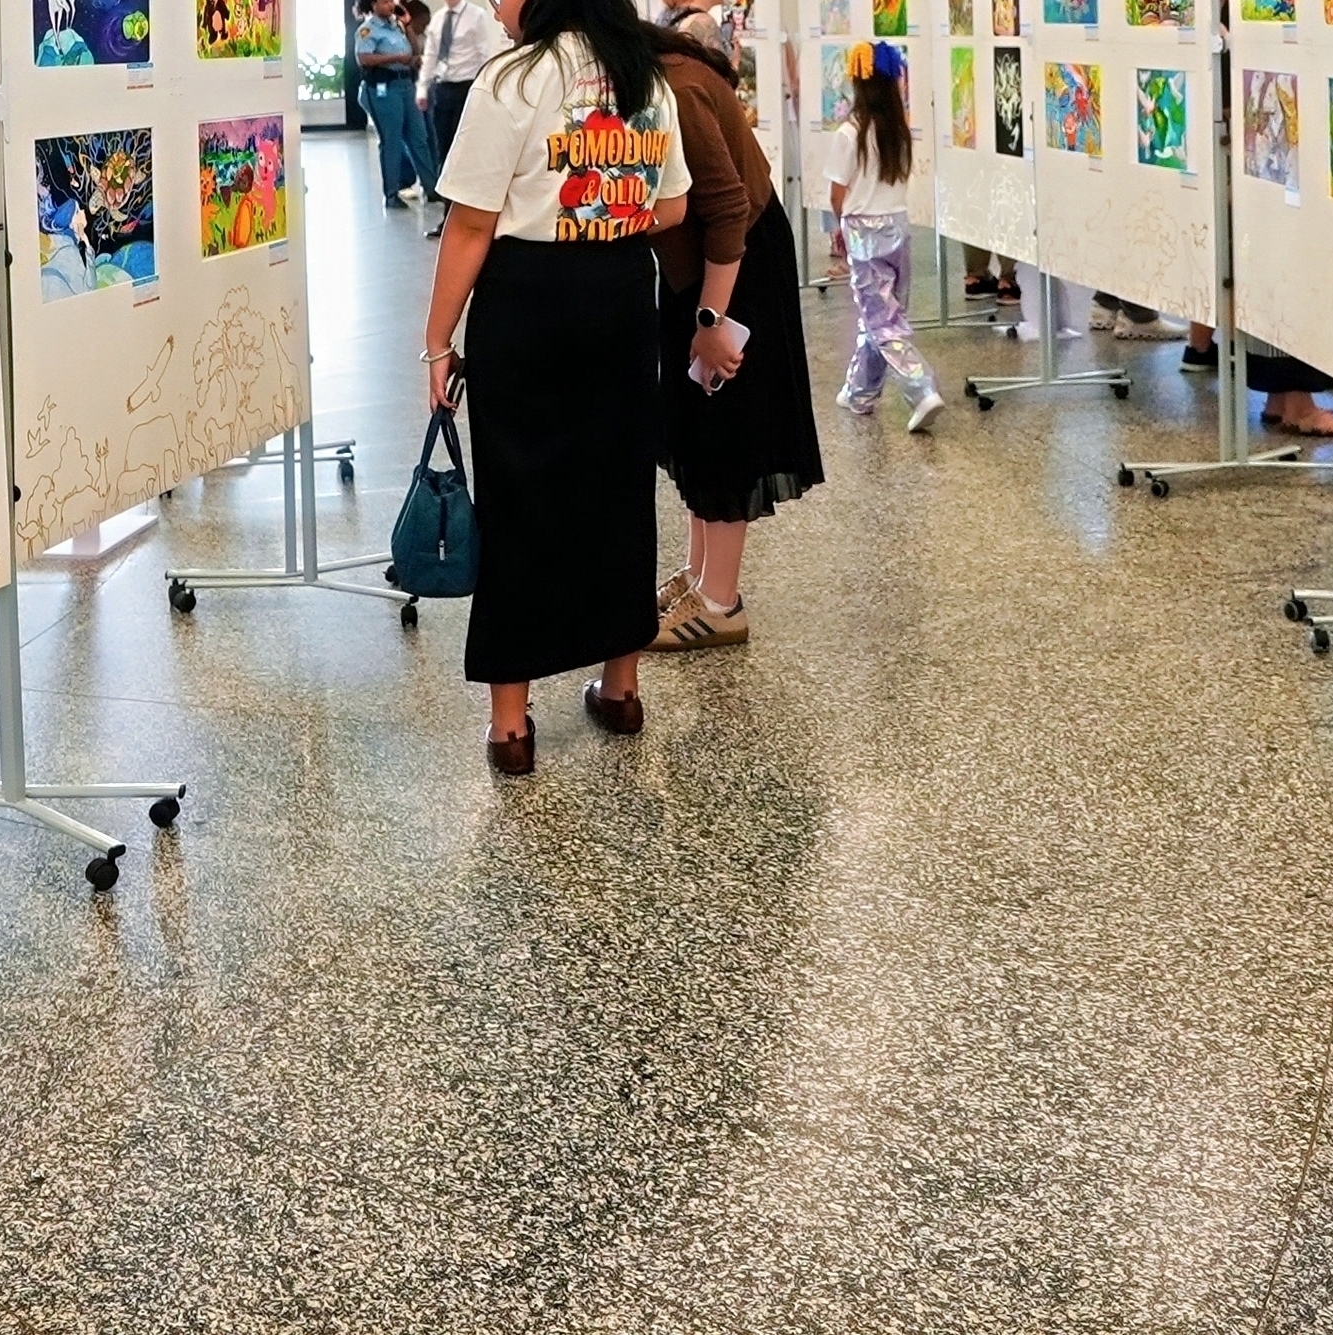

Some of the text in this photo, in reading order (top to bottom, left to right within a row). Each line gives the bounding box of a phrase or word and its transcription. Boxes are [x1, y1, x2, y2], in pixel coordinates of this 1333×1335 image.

[547, 128, 670, 172] POMODOR
[580, 176, 649, 207] & OLIO
